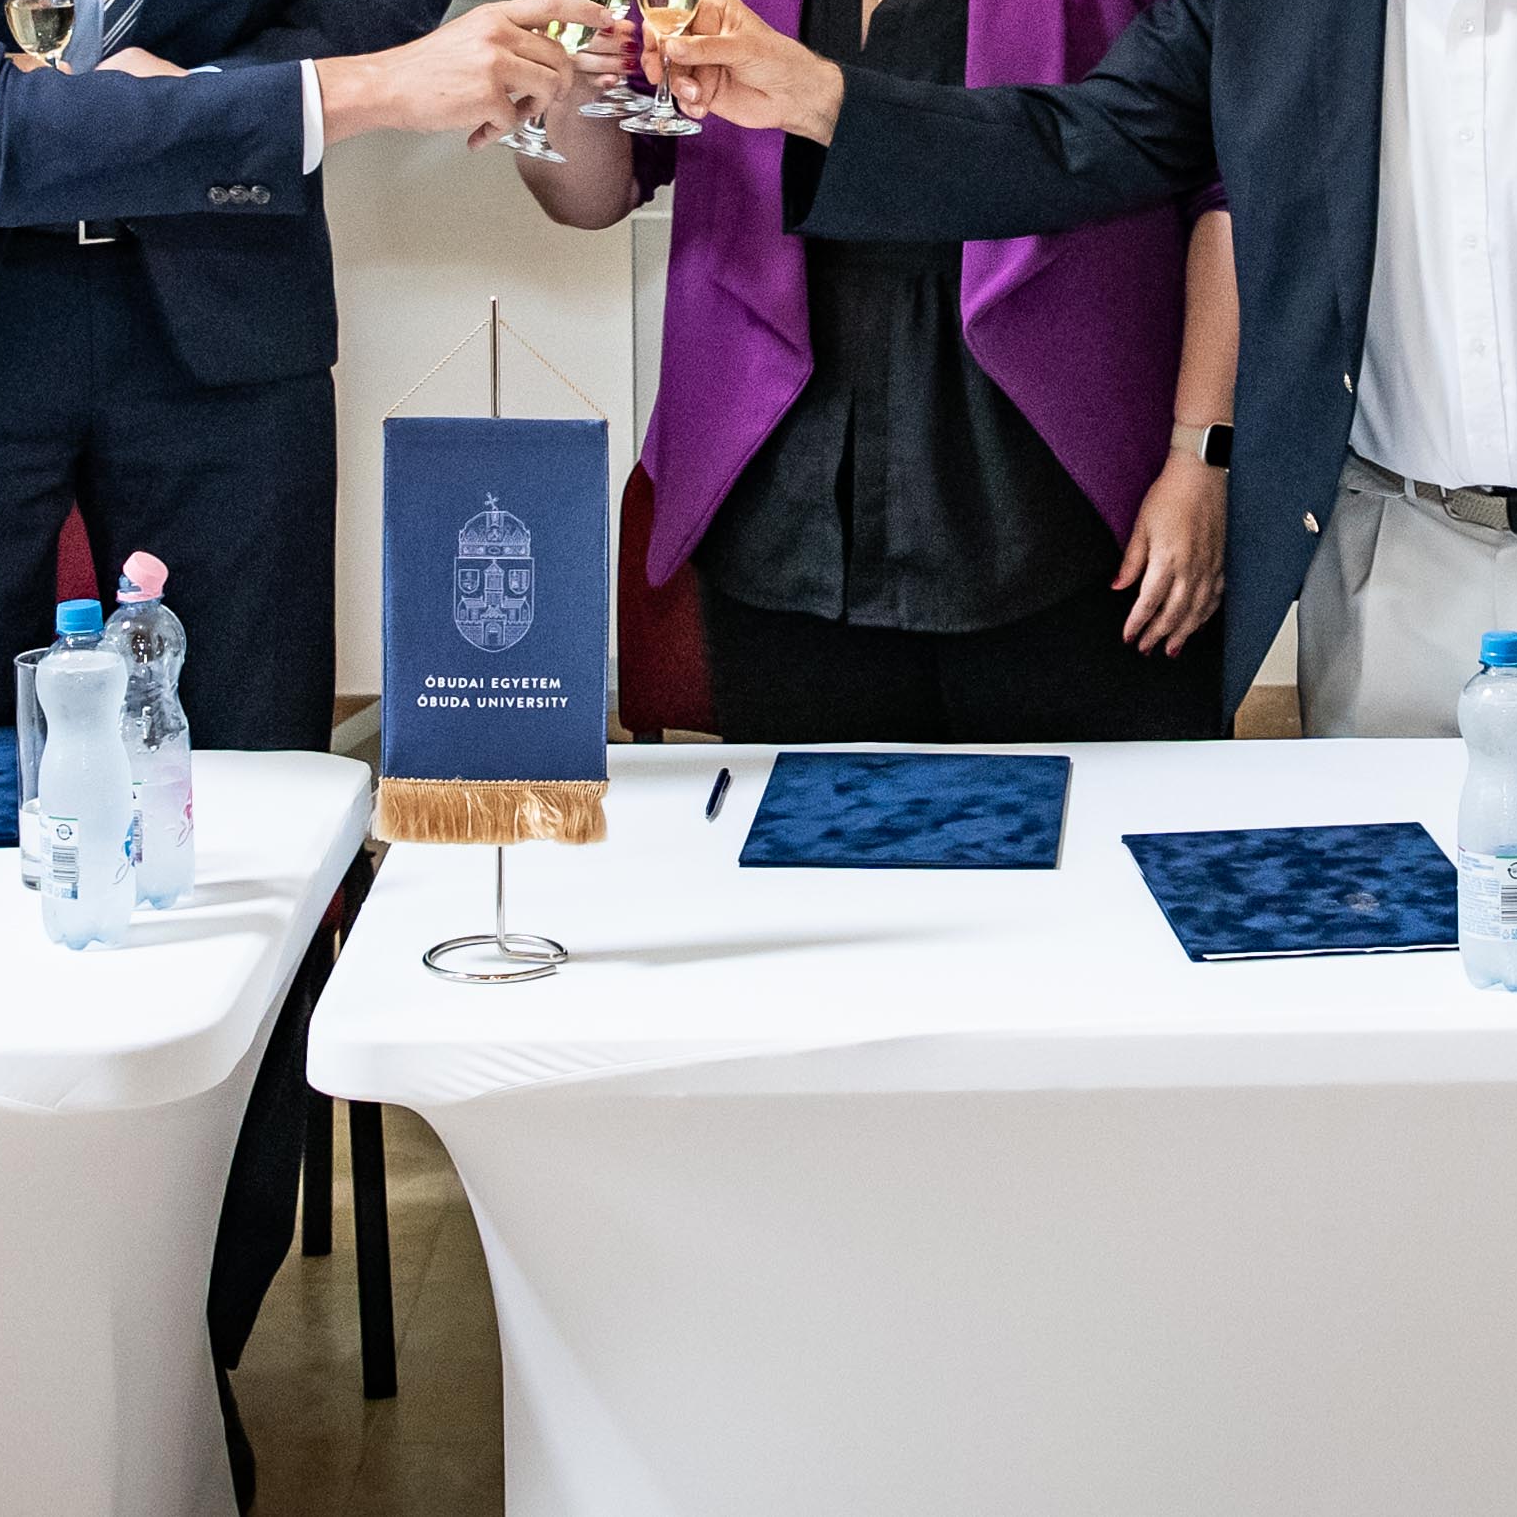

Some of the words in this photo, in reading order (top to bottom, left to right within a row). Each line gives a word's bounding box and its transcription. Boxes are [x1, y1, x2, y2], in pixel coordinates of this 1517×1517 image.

[424, 674, 484, 689] ÓBUDAI
[491, 677, 561, 689] EGYETEM
[416, 693, 471, 708] ÓBUDA
[476, 696, 569, 709] UNIVERSITY
